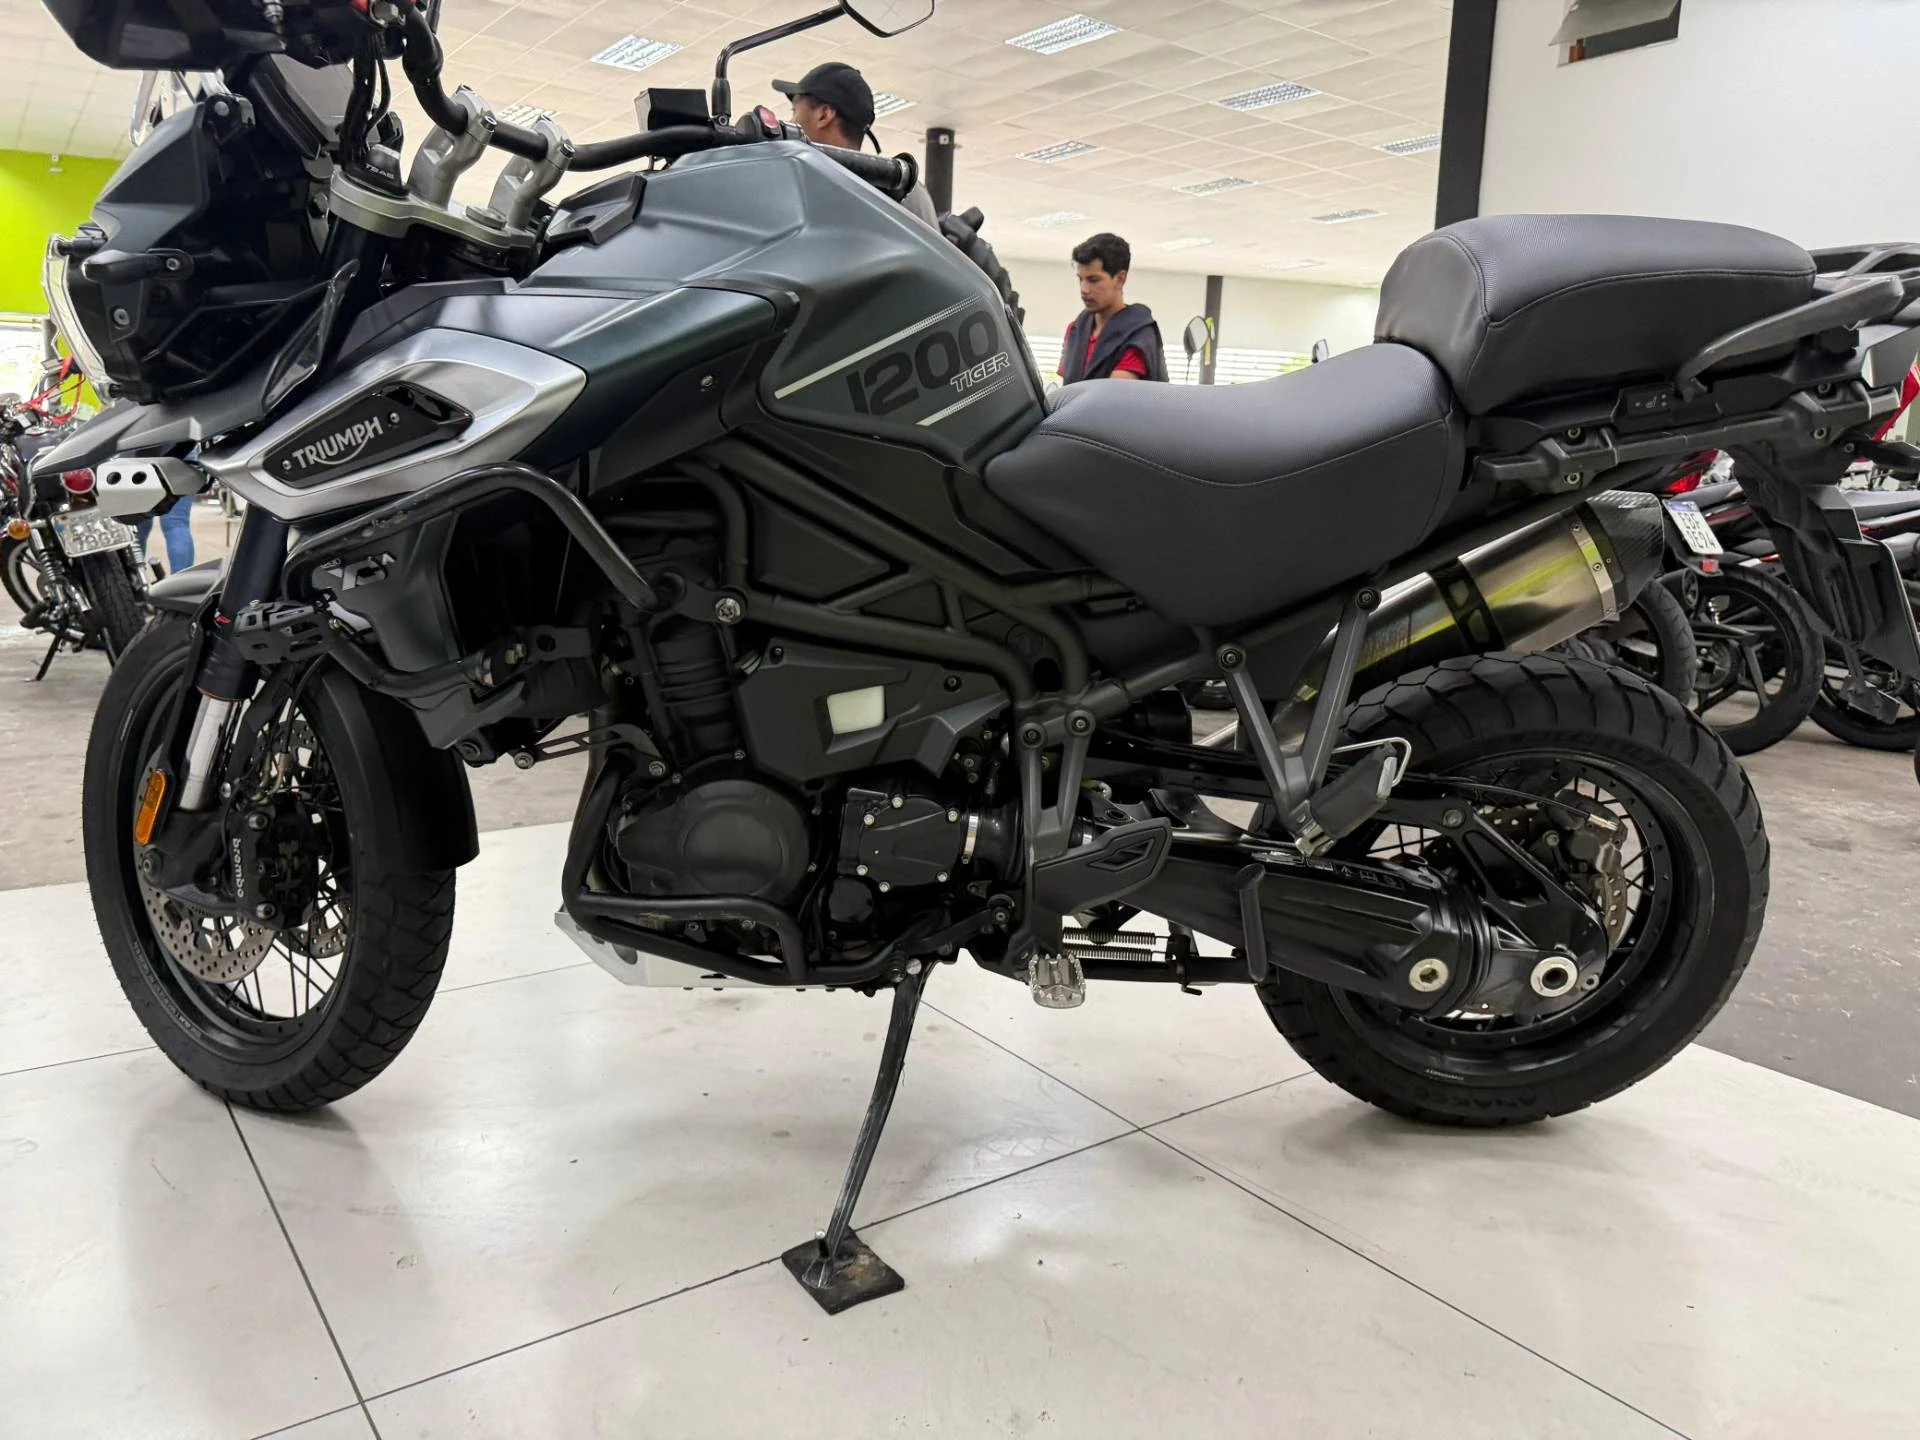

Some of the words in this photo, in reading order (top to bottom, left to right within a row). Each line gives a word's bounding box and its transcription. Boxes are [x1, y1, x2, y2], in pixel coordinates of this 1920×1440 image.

[846, 310, 999, 417] 1200
[950, 351, 1011, 392] TIGER
[292, 416, 384, 469] TRIUMPH
[232, 838, 245, 898] brembo
